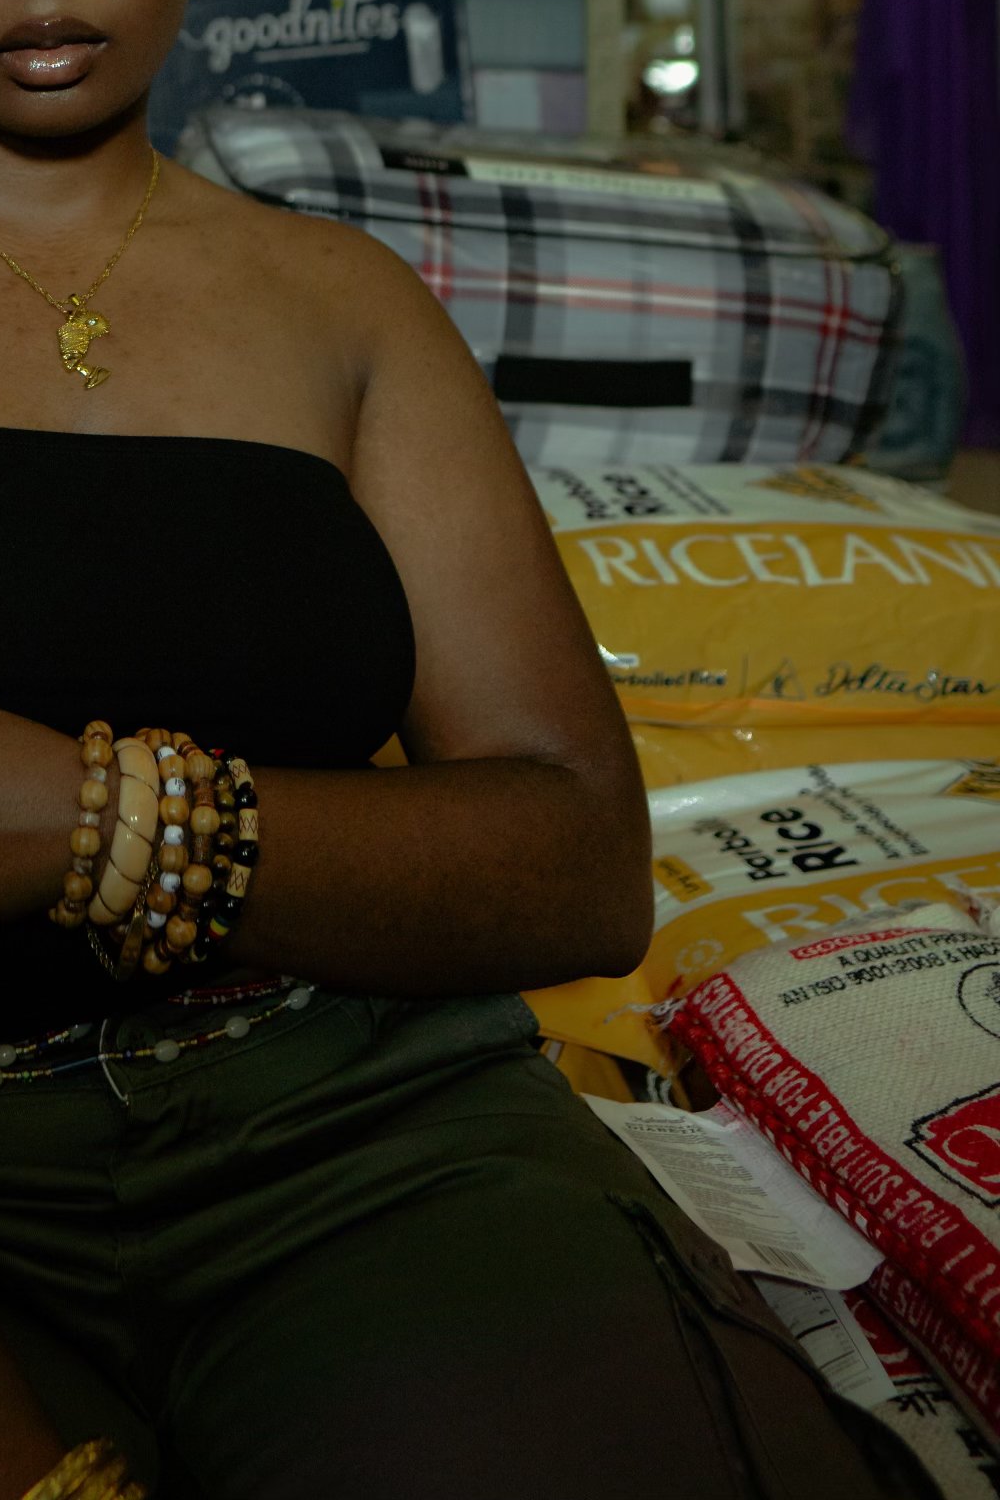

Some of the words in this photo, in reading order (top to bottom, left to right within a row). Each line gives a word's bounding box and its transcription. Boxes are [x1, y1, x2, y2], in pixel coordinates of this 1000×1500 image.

[578, 533, 1000, 588] RICELAN
[693, 818, 787, 882] Parbo
[759, 804, 861, 874] Rice
[741, 865, 1000, 942] RICE
[853, 937, 928, 964] QUALITY
[808, 974, 848, 997] ISO
[692, 977, 783, 1085] DIABETICS
[762, 1064, 821, 1119] FOR
[797, 1100, 904, 1205] SUITABLE
[882, 1188, 961, 1249] RICE
